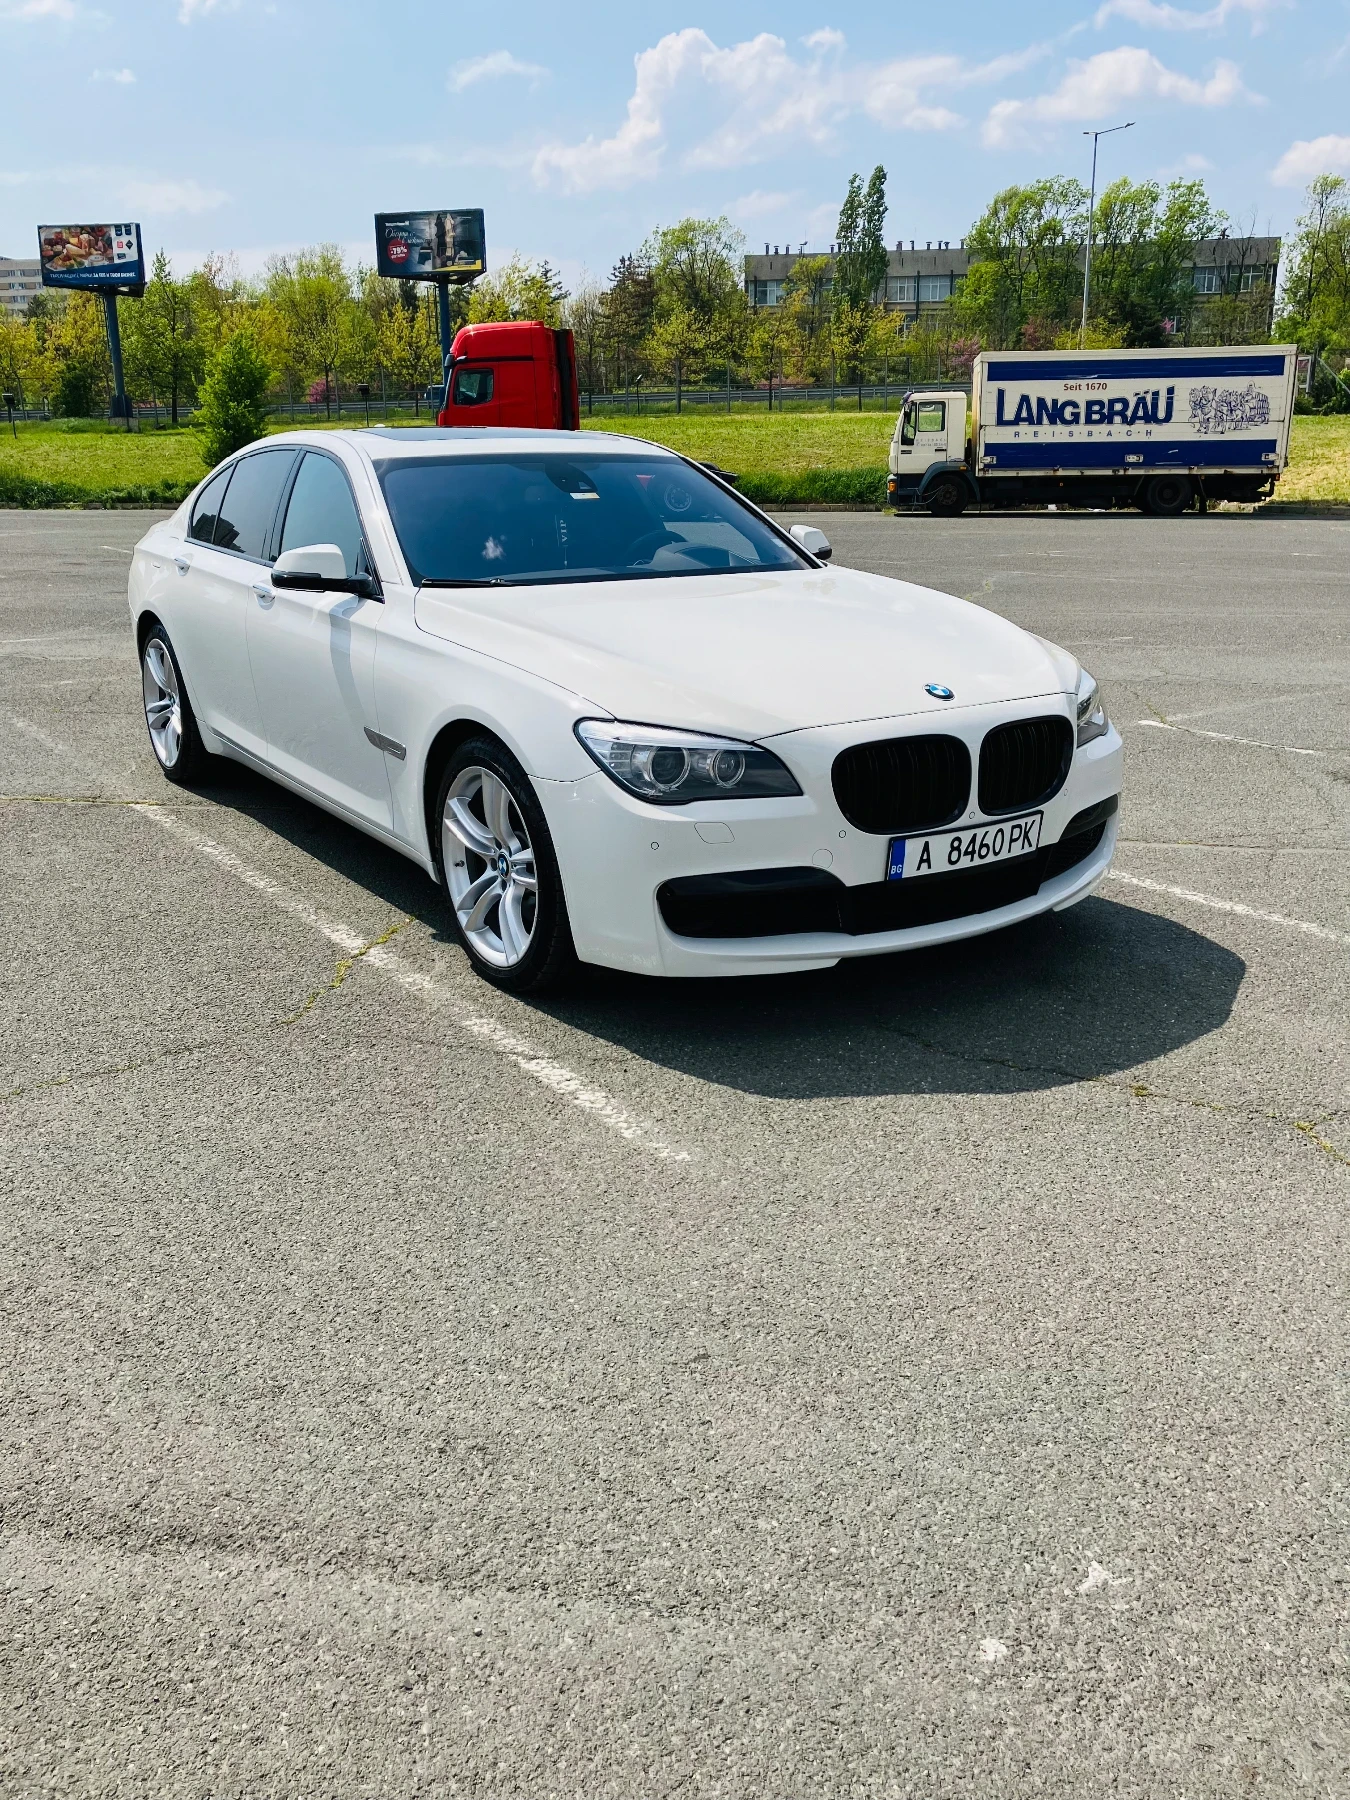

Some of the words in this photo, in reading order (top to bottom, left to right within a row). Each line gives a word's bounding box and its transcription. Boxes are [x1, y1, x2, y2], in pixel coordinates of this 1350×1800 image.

[1063, 382, 1083, 391] Seit
[1085, 382, 1108, 391] 1670
[560, 519, 568, 543] VIP
[890, 863, 903, 875] BG
